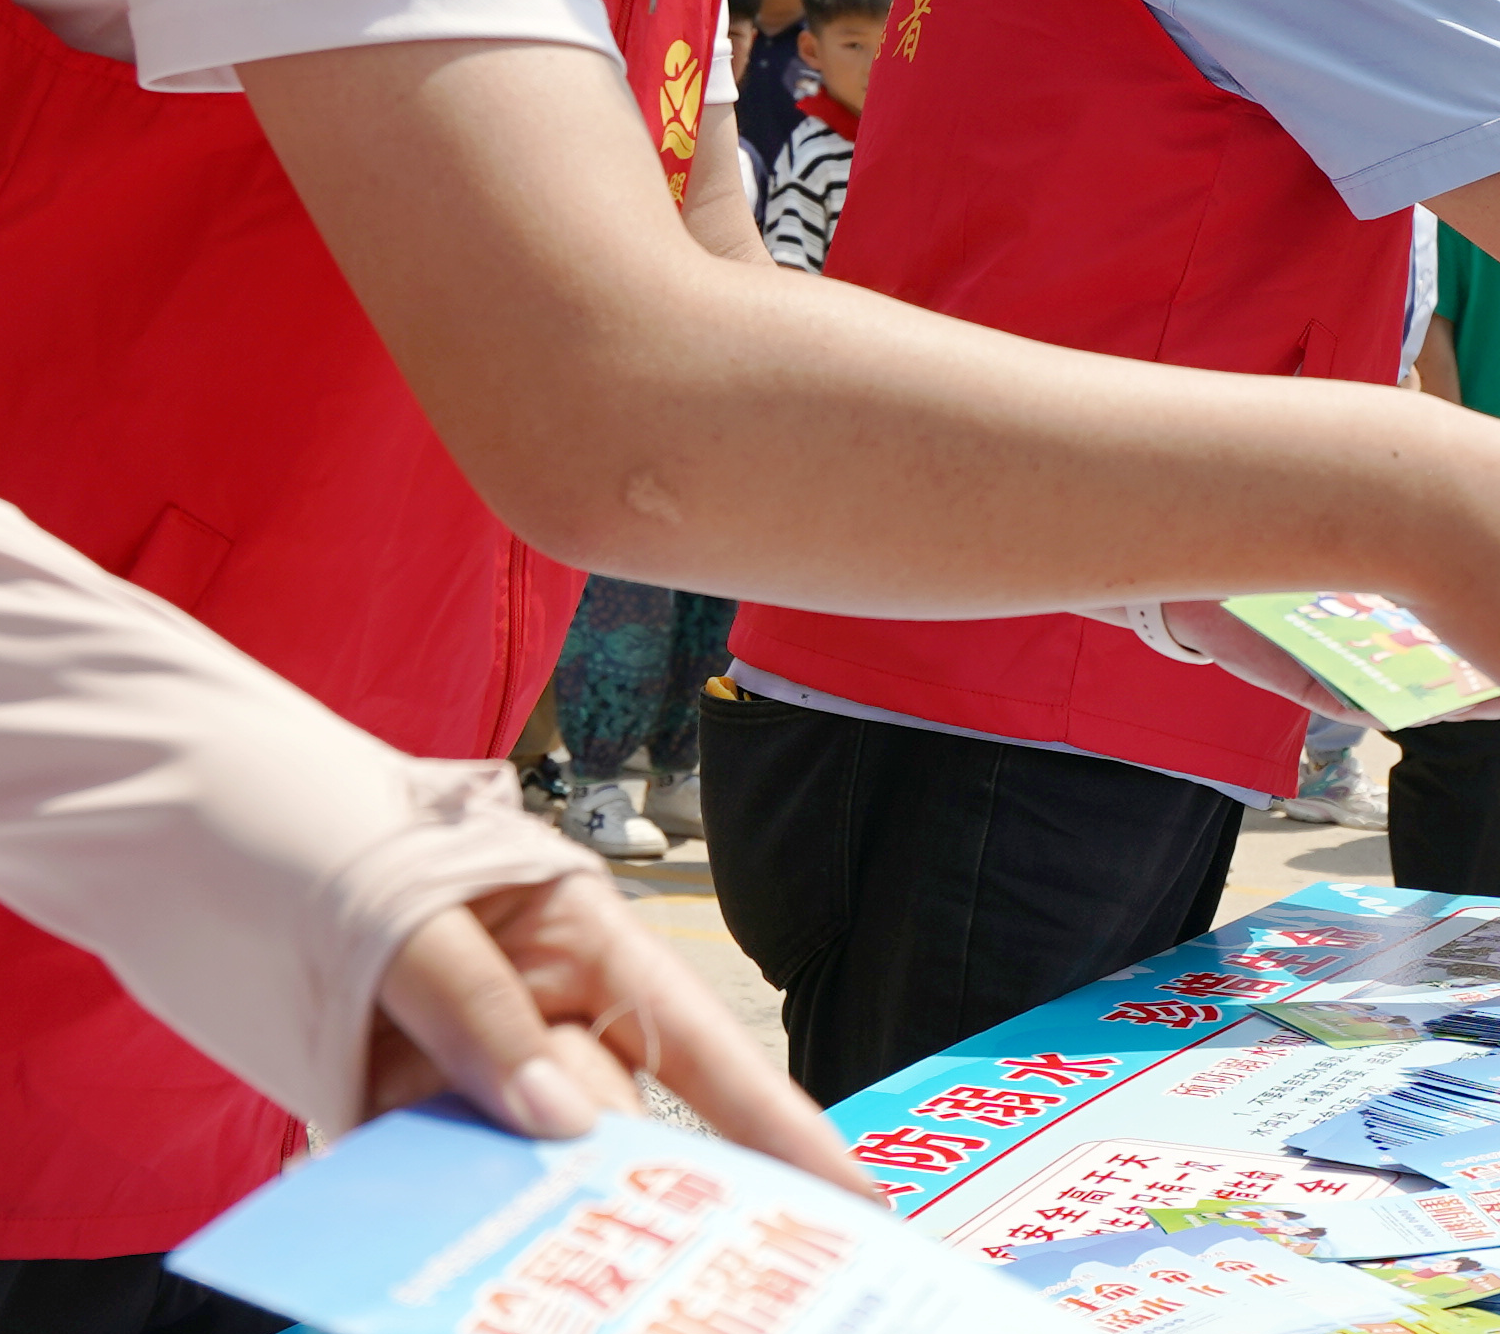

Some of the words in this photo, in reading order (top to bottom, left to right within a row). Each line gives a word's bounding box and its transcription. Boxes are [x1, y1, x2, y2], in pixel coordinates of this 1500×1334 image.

[1100, 924, 1387, 1031] 珍惜生命
[849, 1051, 1125, 1211] 防溺水
